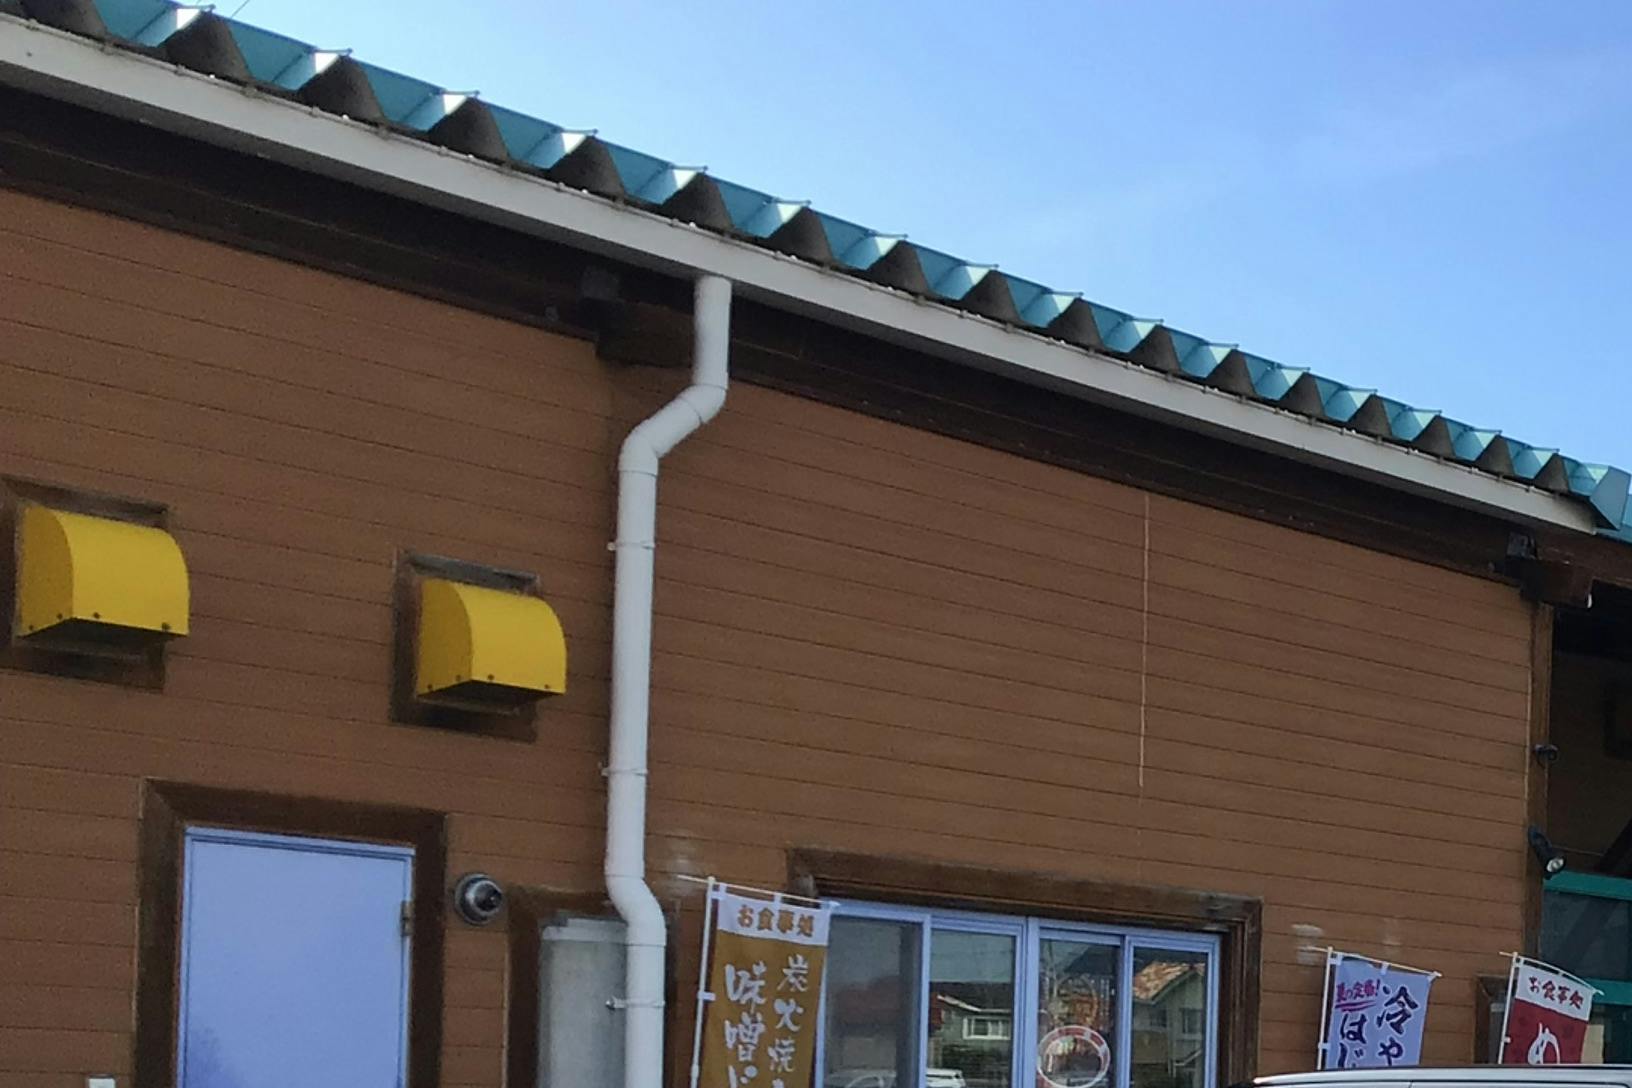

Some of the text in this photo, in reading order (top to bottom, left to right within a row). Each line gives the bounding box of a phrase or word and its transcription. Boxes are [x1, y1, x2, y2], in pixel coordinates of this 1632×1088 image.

[738, 904, 814, 937] お食事処
[1529, 976, 1584, 1010] お食事処
